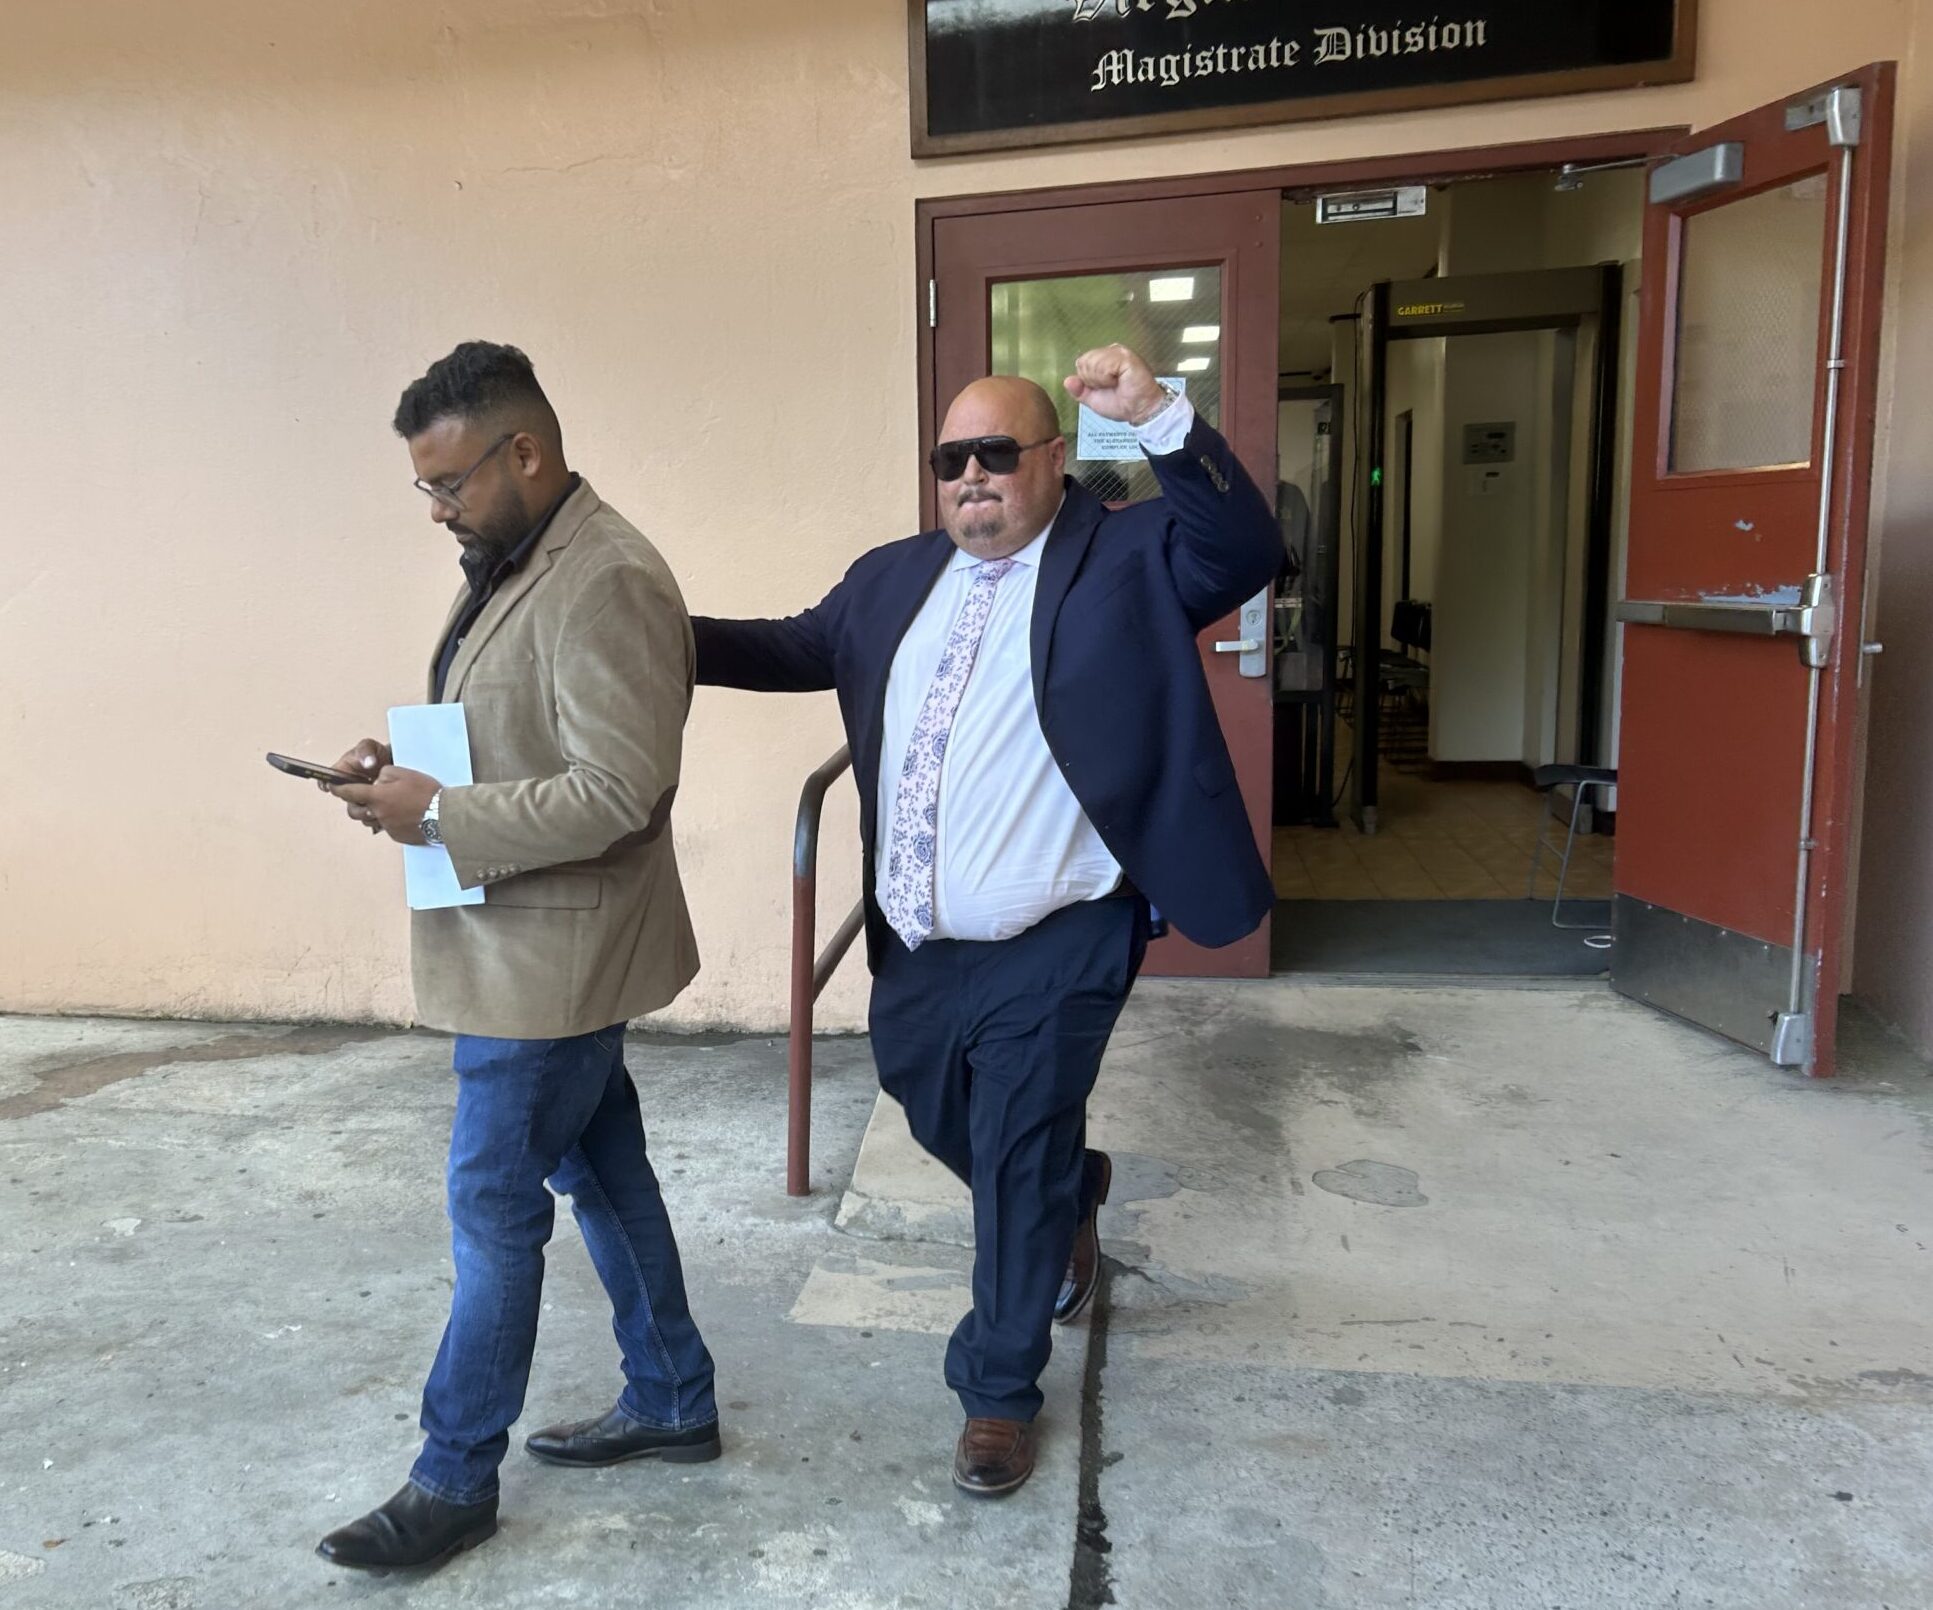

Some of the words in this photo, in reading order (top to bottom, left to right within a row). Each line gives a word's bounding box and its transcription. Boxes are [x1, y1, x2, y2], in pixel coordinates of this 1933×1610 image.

[1090, 36, 1301, 92] Magistrate
[1313, 15, 1487, 66] Division
[1398, 304, 1443, 316] GARRETT
